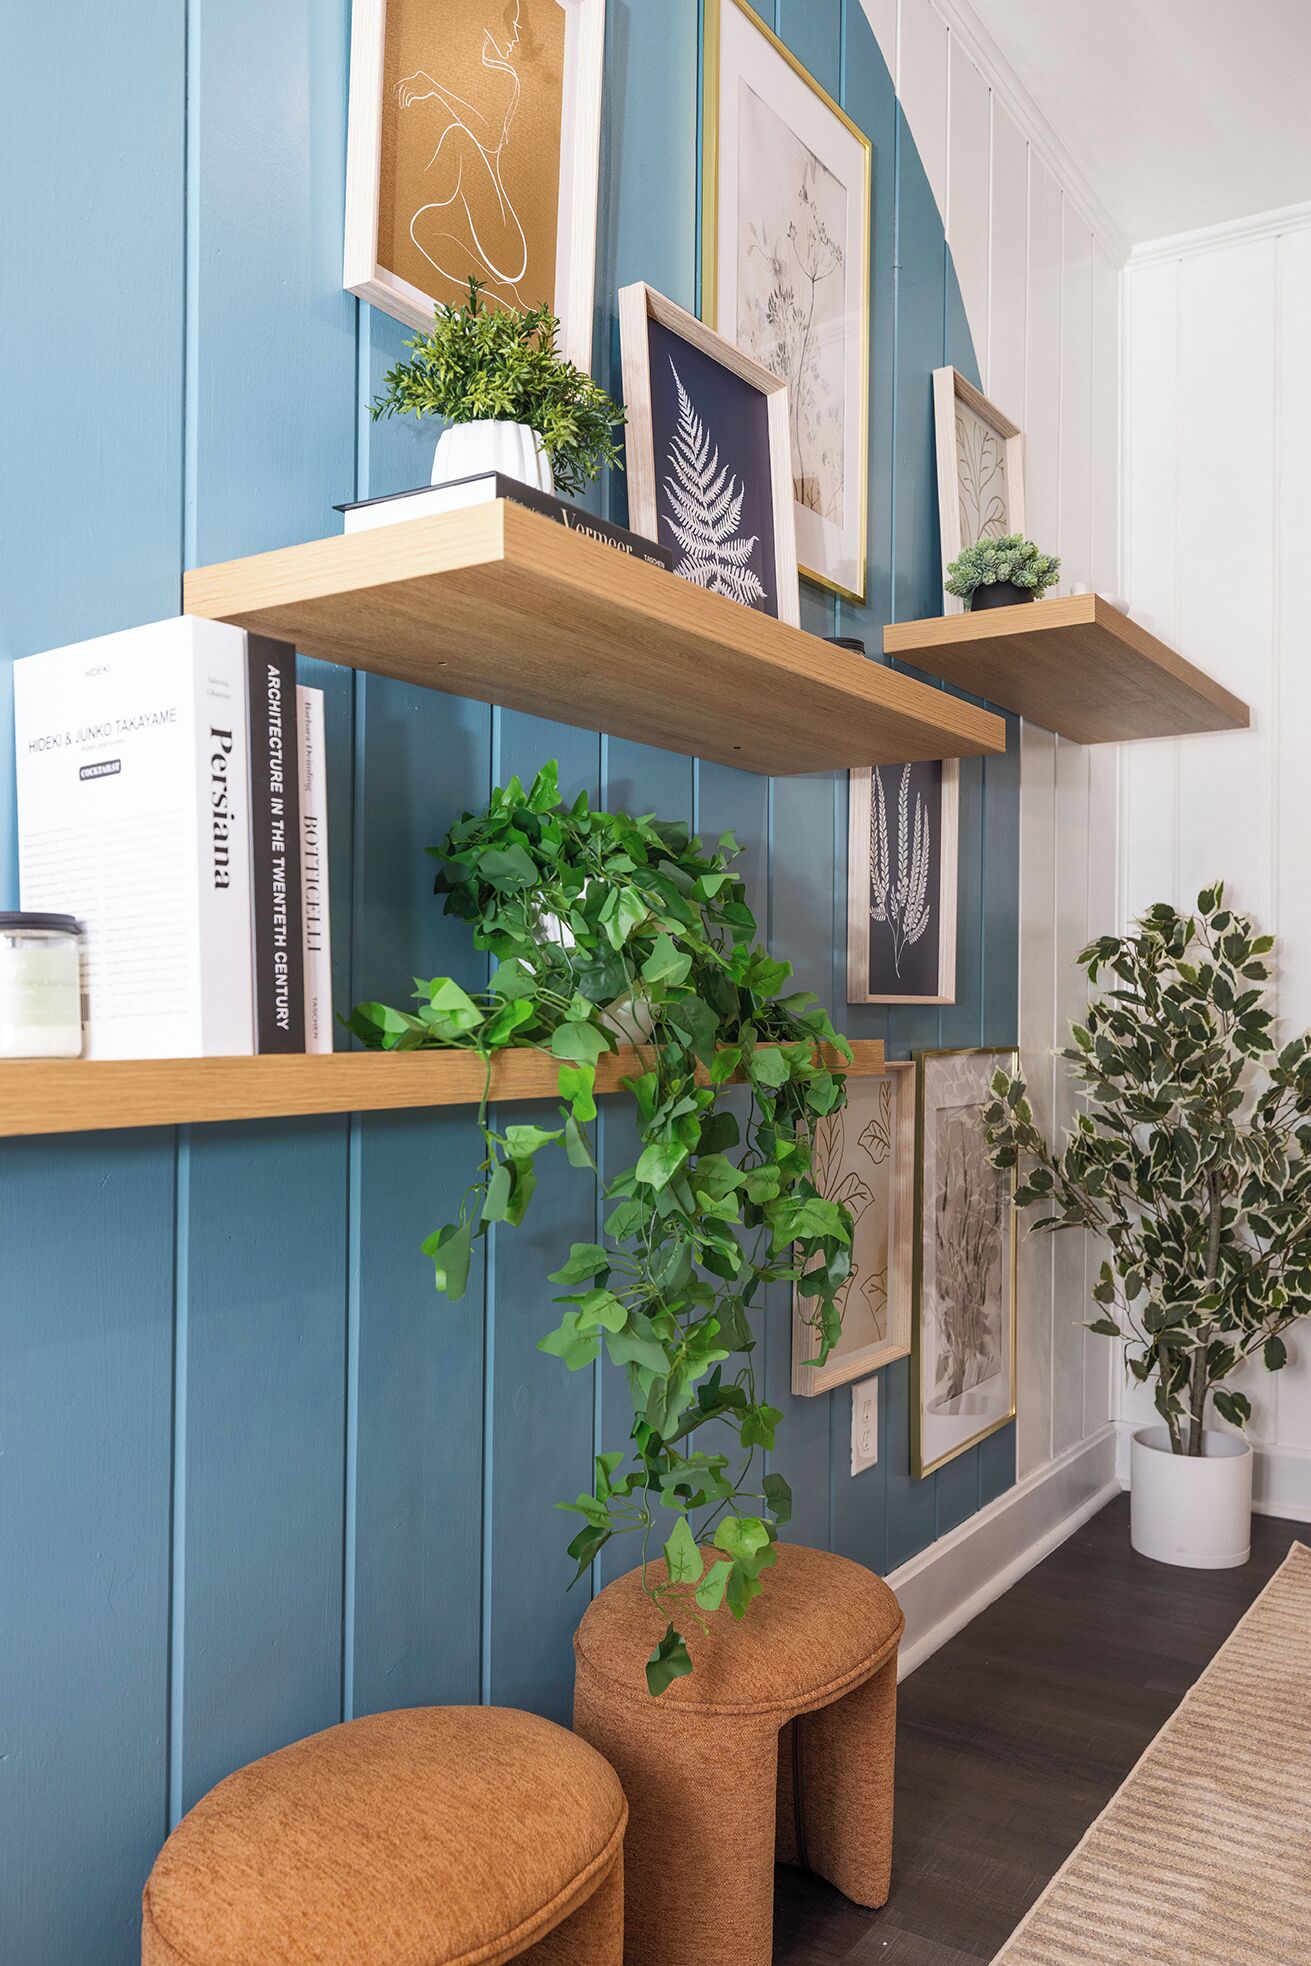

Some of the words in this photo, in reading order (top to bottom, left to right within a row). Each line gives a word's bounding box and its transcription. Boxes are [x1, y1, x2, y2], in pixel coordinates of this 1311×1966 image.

[643, 554, 665, 569] TASCHEN
[84, 664, 111, 678] HIDEKI
[28, 733, 63, 754] HIDEKI
[64, 731, 72, 746] &
[75, 722, 112, 743] JUNKO
[115, 707, 177, 735] TAKAYAME
[267, 664, 283, 793] ARCHITECTURE
[304, 702, 312, 742] Barbara
[210, 726, 234, 890] Persiana
[271, 797, 284, 815] IN
[271, 819, 285, 852] THE
[304, 815, 321, 951] BOTTICELLI
[274, 951, 289, 1031] CENTURY
